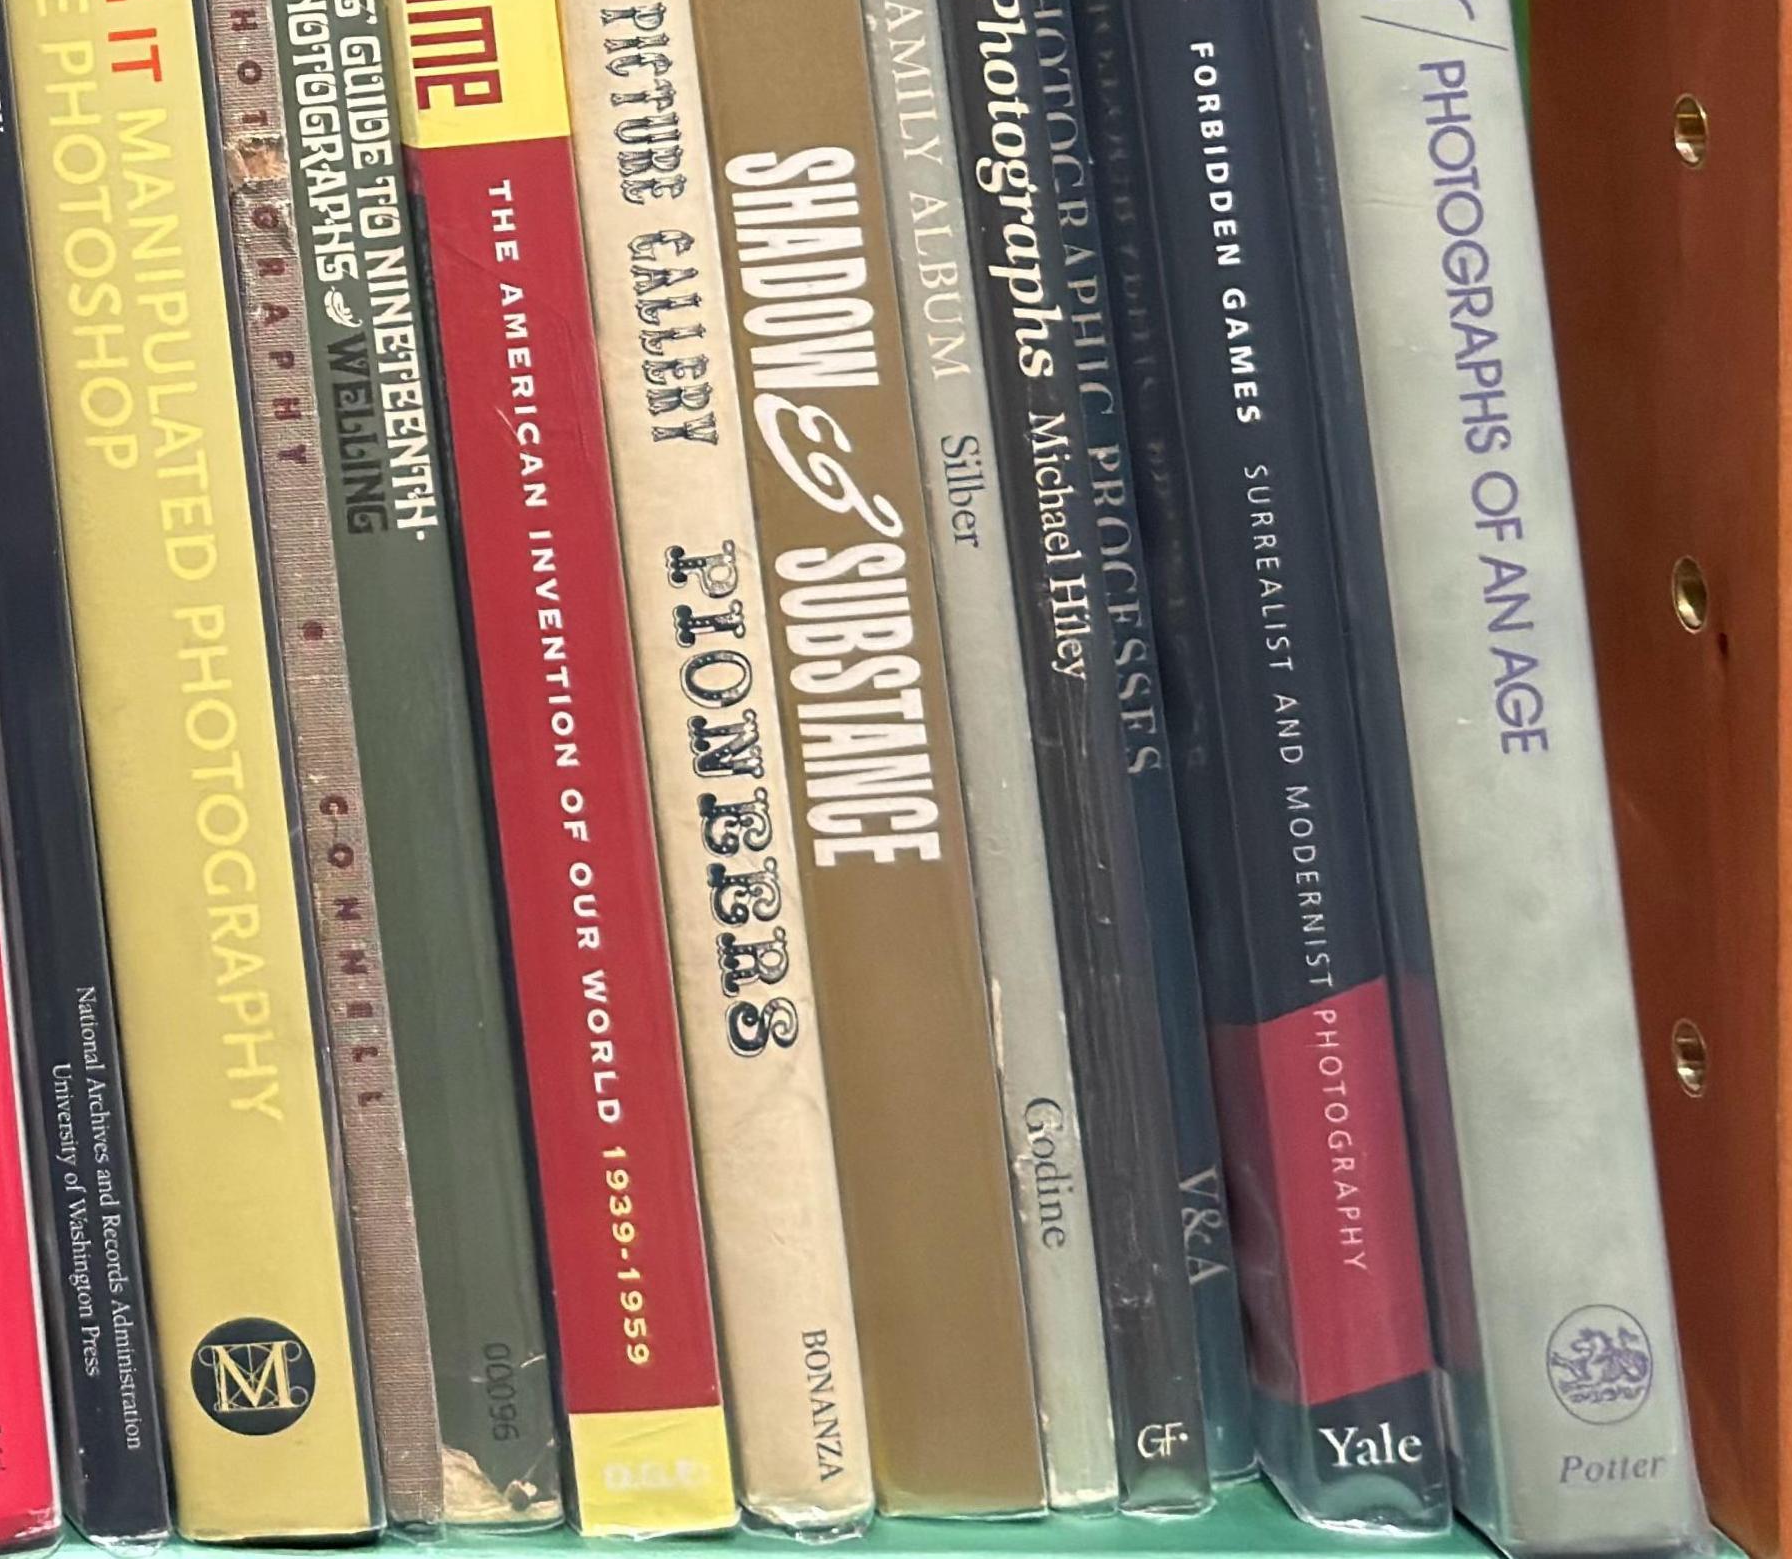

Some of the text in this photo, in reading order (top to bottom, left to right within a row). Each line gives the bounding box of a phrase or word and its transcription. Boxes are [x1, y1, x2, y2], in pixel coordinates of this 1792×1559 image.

[104, 26, 164, 82] IT
[42, 38, 139, 471] PHOTOSHOP
[115, 106, 218, 583] MANIPULATED
[598, 1, 719, 446] PICTURE GALLERY
[327, 333, 390, 539] WELLING
[724, 146, 944, 869] SHADOW & SUBSTANCE
[939, 433, 987, 550] Silber
[1027, 409, 1082, 565] Michael
[487, 179, 652, 1367] THE AMERICAN INVENTION OF OUR WORLD 1939-1959
[1047, 575, 1095, 682] Hiley
[1189, 41, 1368, 1273] FORBIDDEN GAMES SURREALIST AND MODERNIST PHOTOGRAPHY
[173, 603, 284, 1124] PHOTOGRAPHY
[665, 538, 800, 1058] PIONEERS
[51, 1062, 103, 1377] University of Washington Press
[76, 985, 143, 1451] National Archives and Records Administration
[1023, 1096, 1067, 1253] Godine
[801, 1328, 849, 1484] BONANZA
[1317, 1422, 1423, 1468] Yale
[1559, 1455, 1666, 1483] Potter
